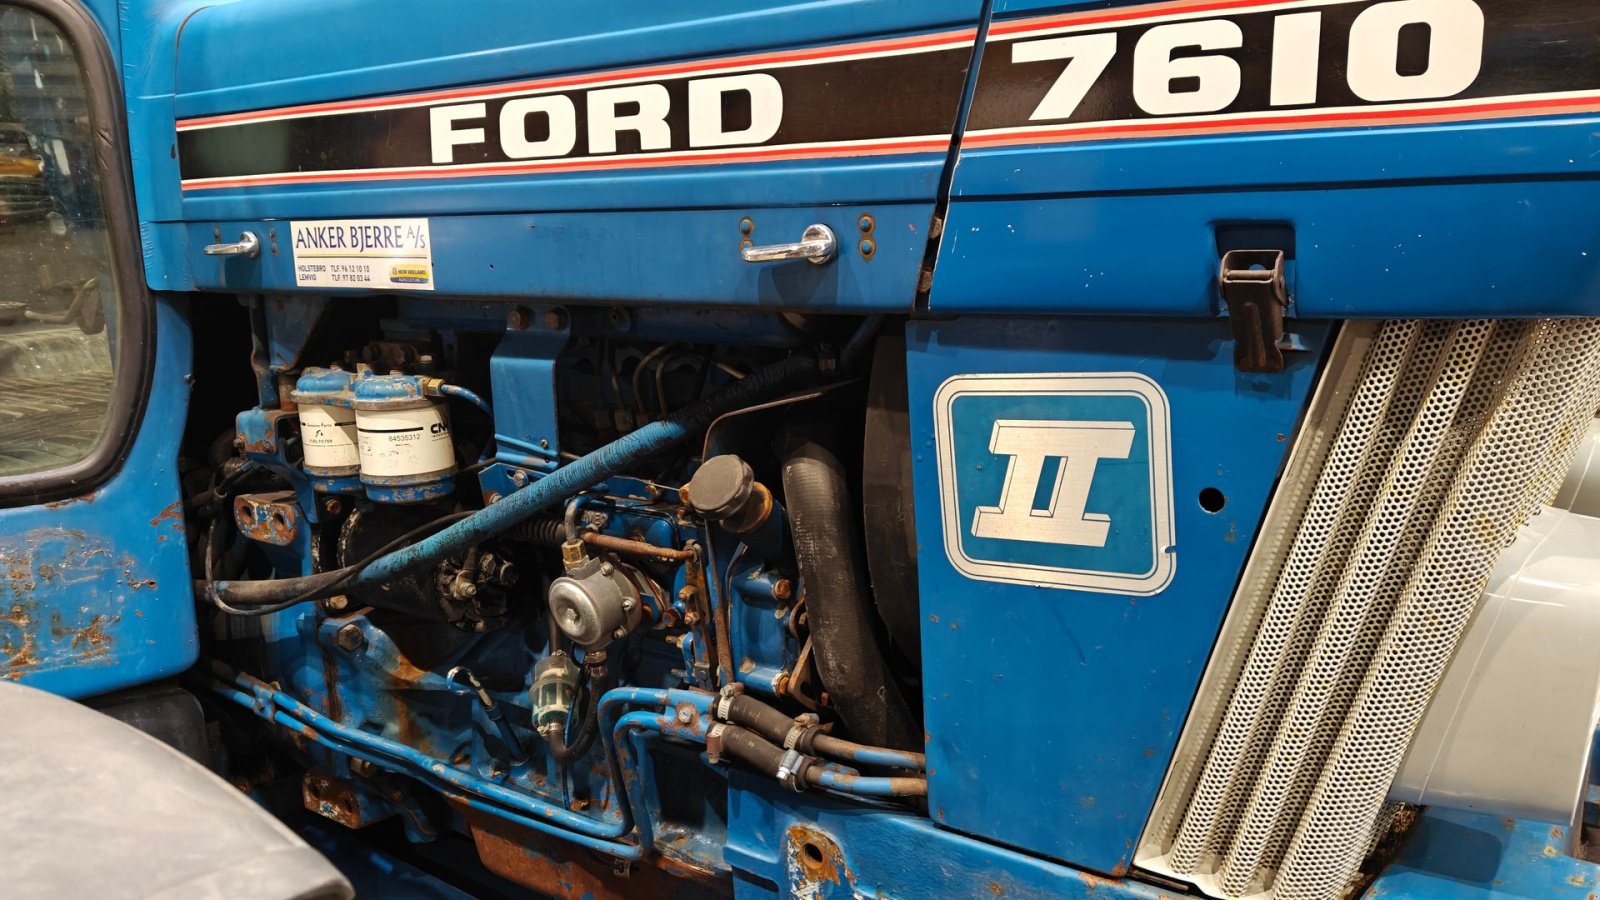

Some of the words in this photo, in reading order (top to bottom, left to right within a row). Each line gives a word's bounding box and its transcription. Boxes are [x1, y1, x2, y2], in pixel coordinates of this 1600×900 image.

[1011, 0, 1485, 121] 7610
[429, 73, 783, 164] FORD
[296, 226, 347, 249] ANKER
[350, 225, 404, 253] BJERRE
[298, 264, 327, 272] HOLSTEBRO
[341, 264, 348, 272] 96
[349, 264, 355, 272] 12
[356, 264, 363, 272] 10
[363, 264, 370, 272] 10
[299, 273, 317, 281] LEMVIG
[349, 274, 356, 282] 82
[356, 274, 363, 282] 03
[364, 274, 371, 282] 44
[388, 433, 421, 442] 84535312
